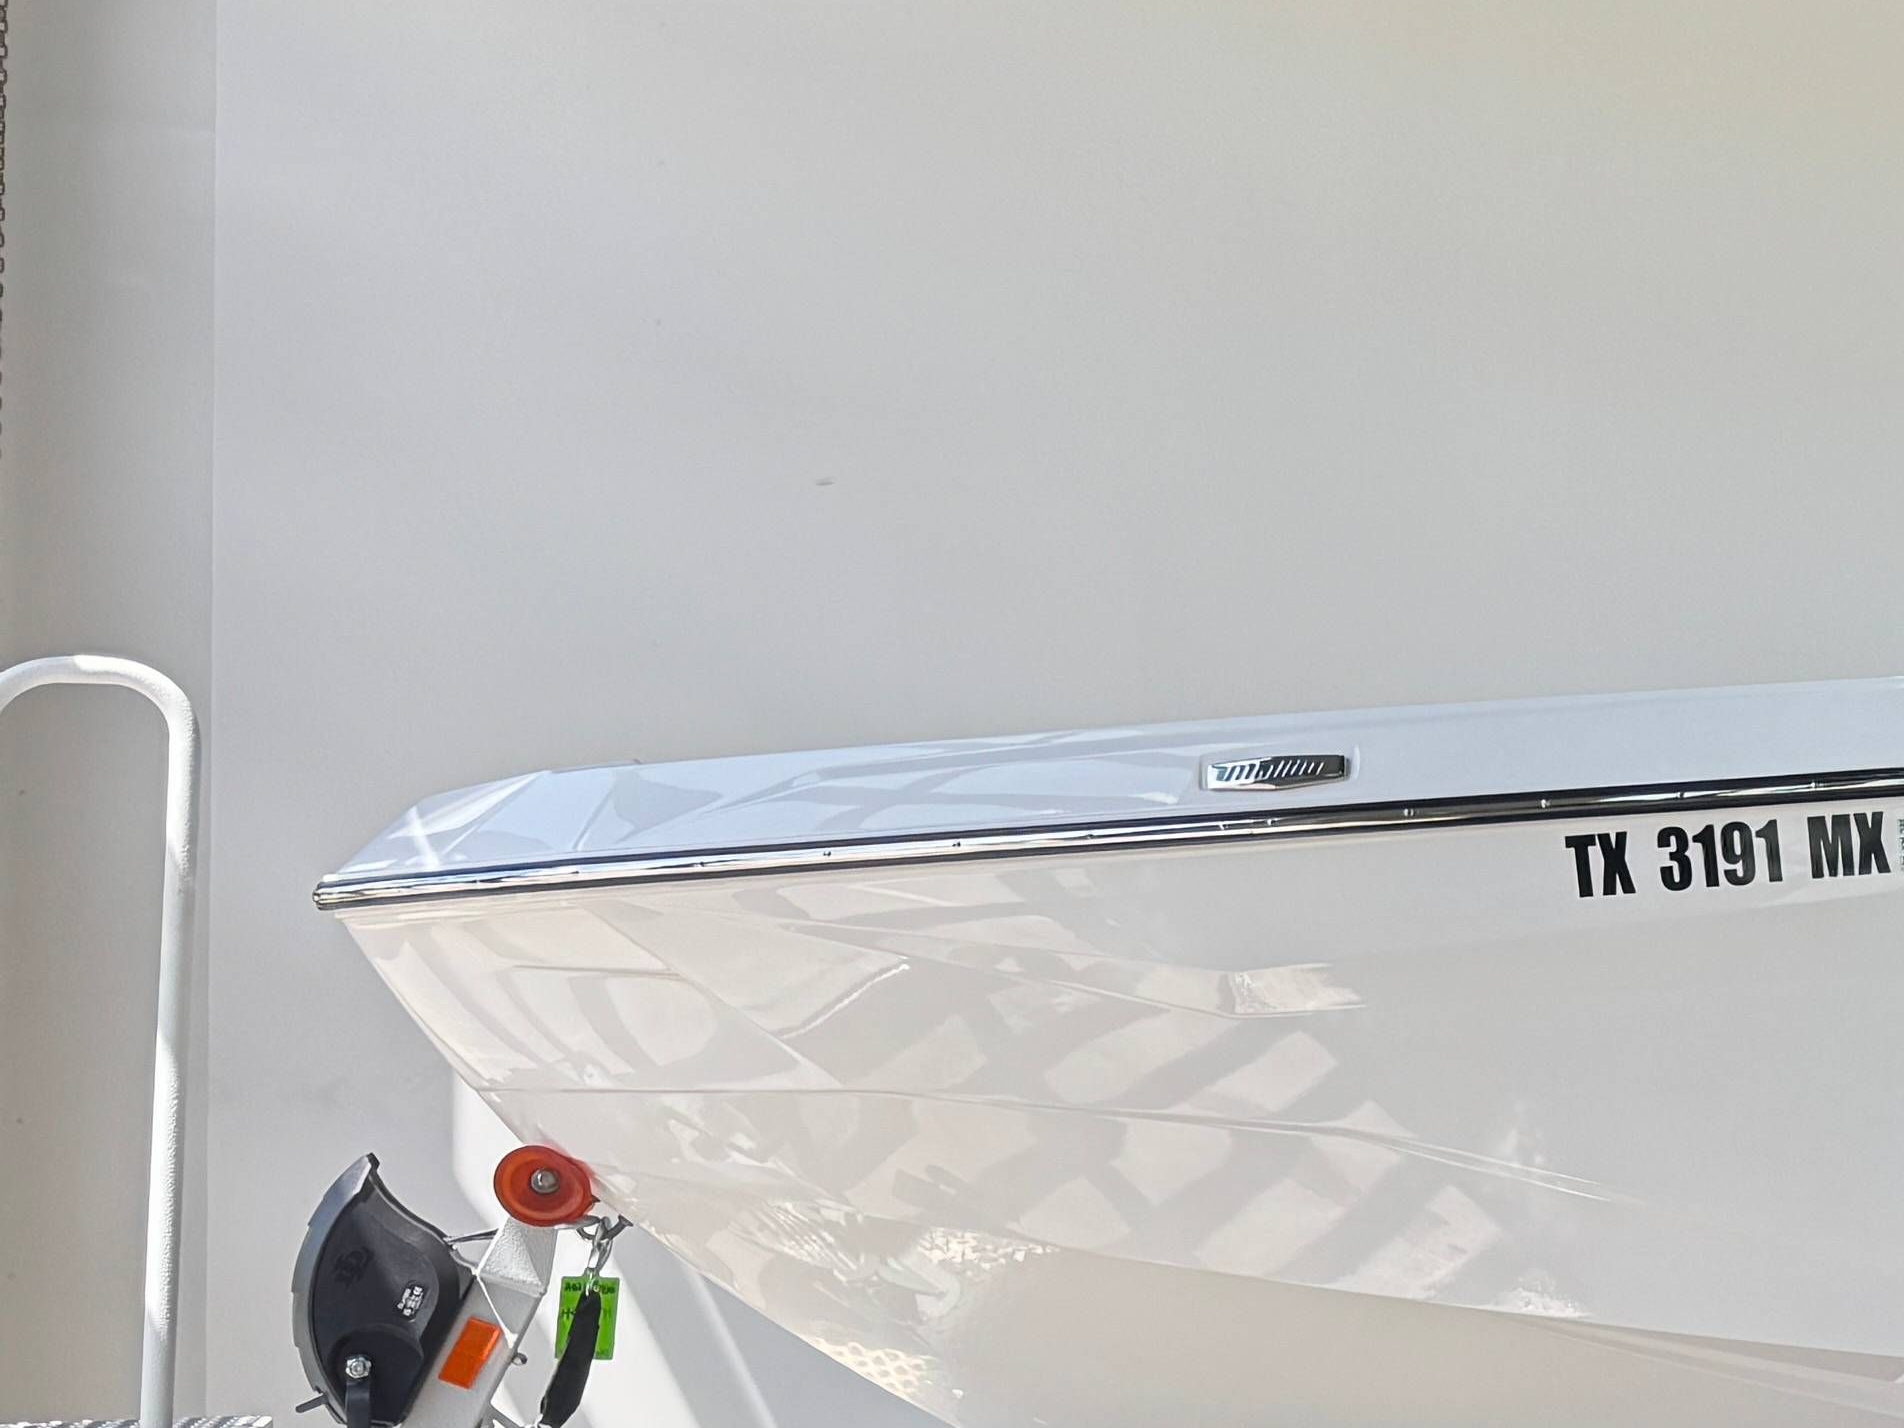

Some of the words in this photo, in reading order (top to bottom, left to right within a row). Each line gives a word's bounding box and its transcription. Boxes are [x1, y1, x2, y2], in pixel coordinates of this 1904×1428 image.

[1565, 831, 1635, 898] TX
[1656, 819, 1783, 890] 3191
[1808, 811, 1891, 879] MX
